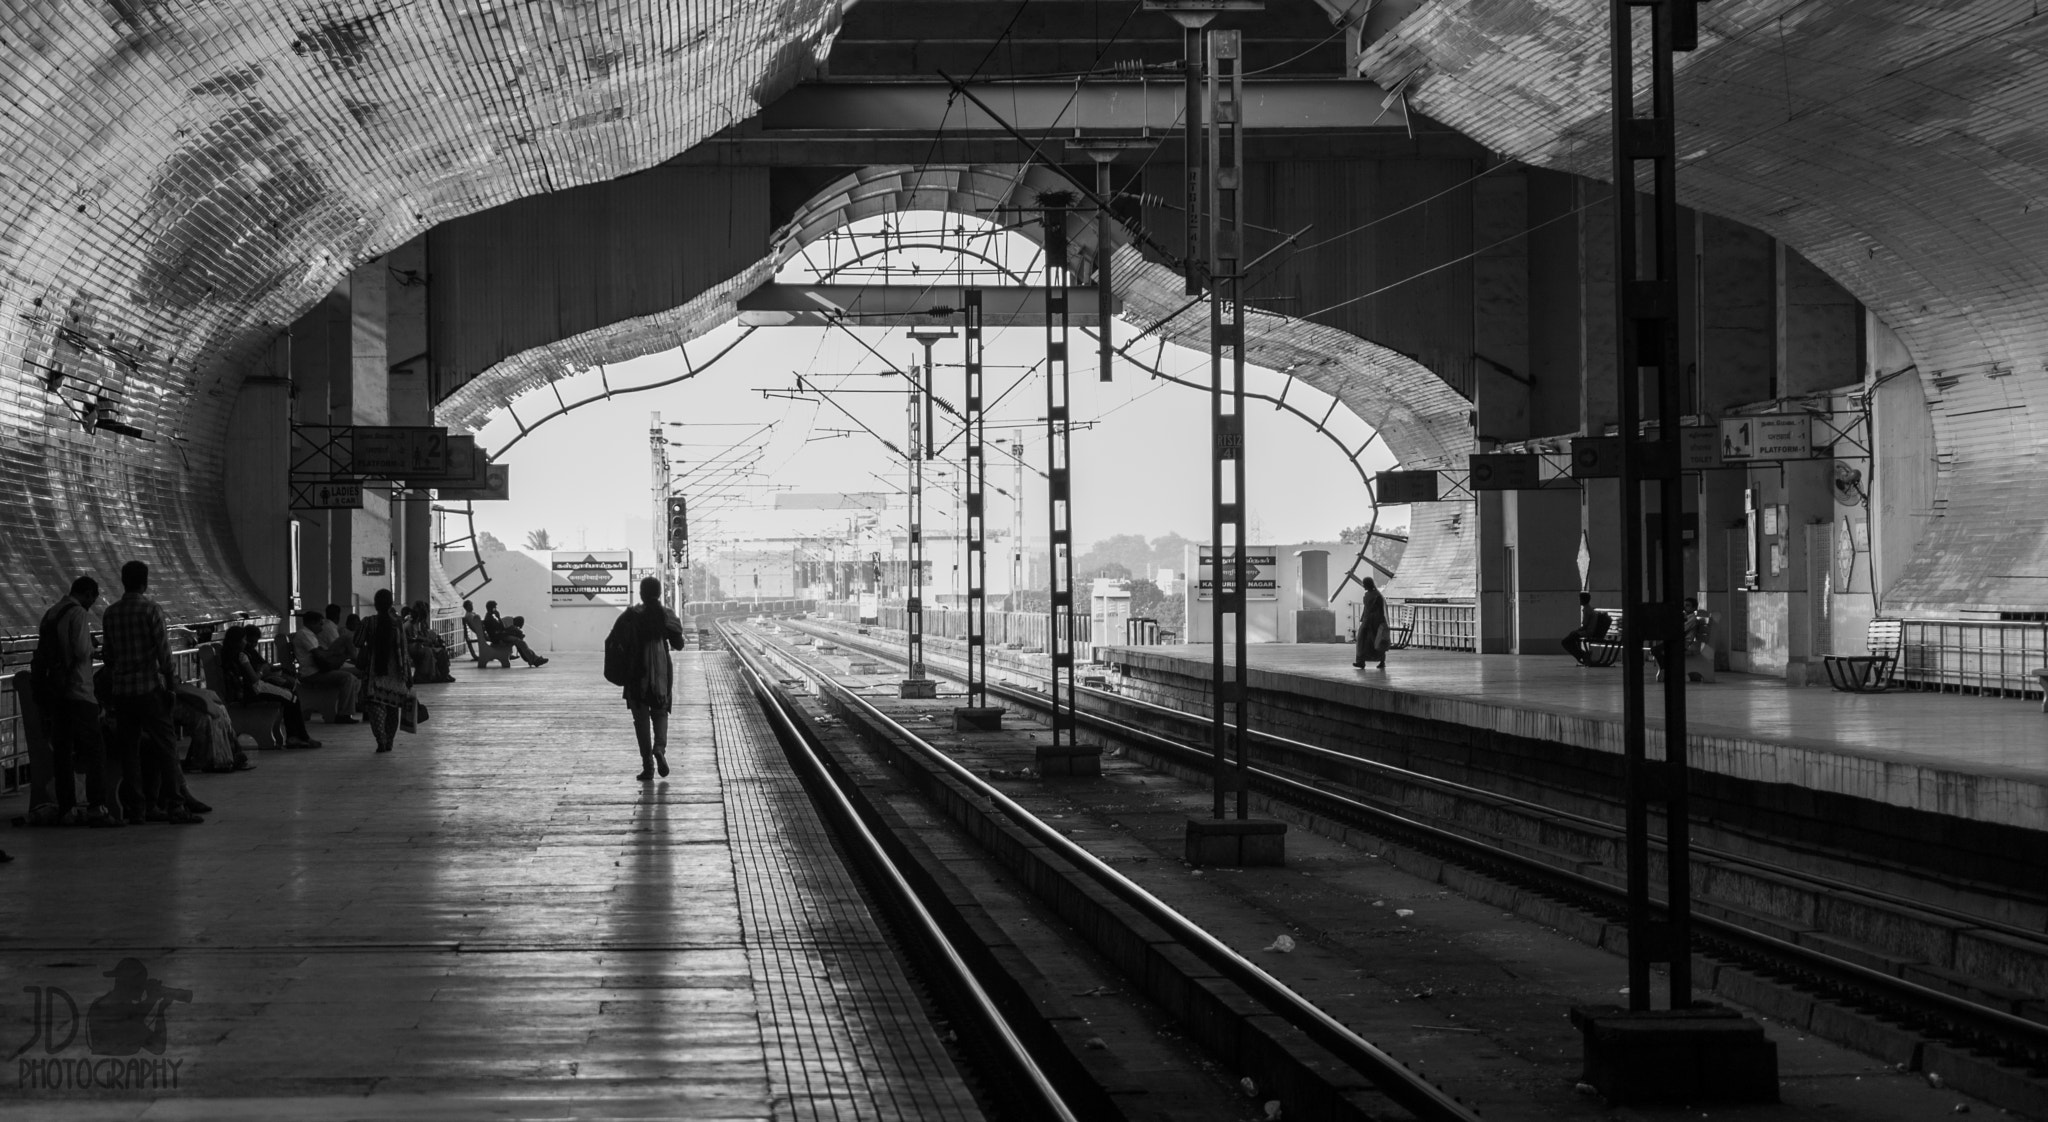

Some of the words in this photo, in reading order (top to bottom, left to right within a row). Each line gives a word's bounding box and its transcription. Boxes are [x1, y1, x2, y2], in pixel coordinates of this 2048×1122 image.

[1217, 434, 1242, 446] RTS12
[1739, 422, 1750, 446] 1
[428, 434, 441, 458] 2
[1759, 445, 1806, 454] PLATFORM-1
[1223, 447, 1237, 459] 41
[331, 486, 360, 497] LADIES
